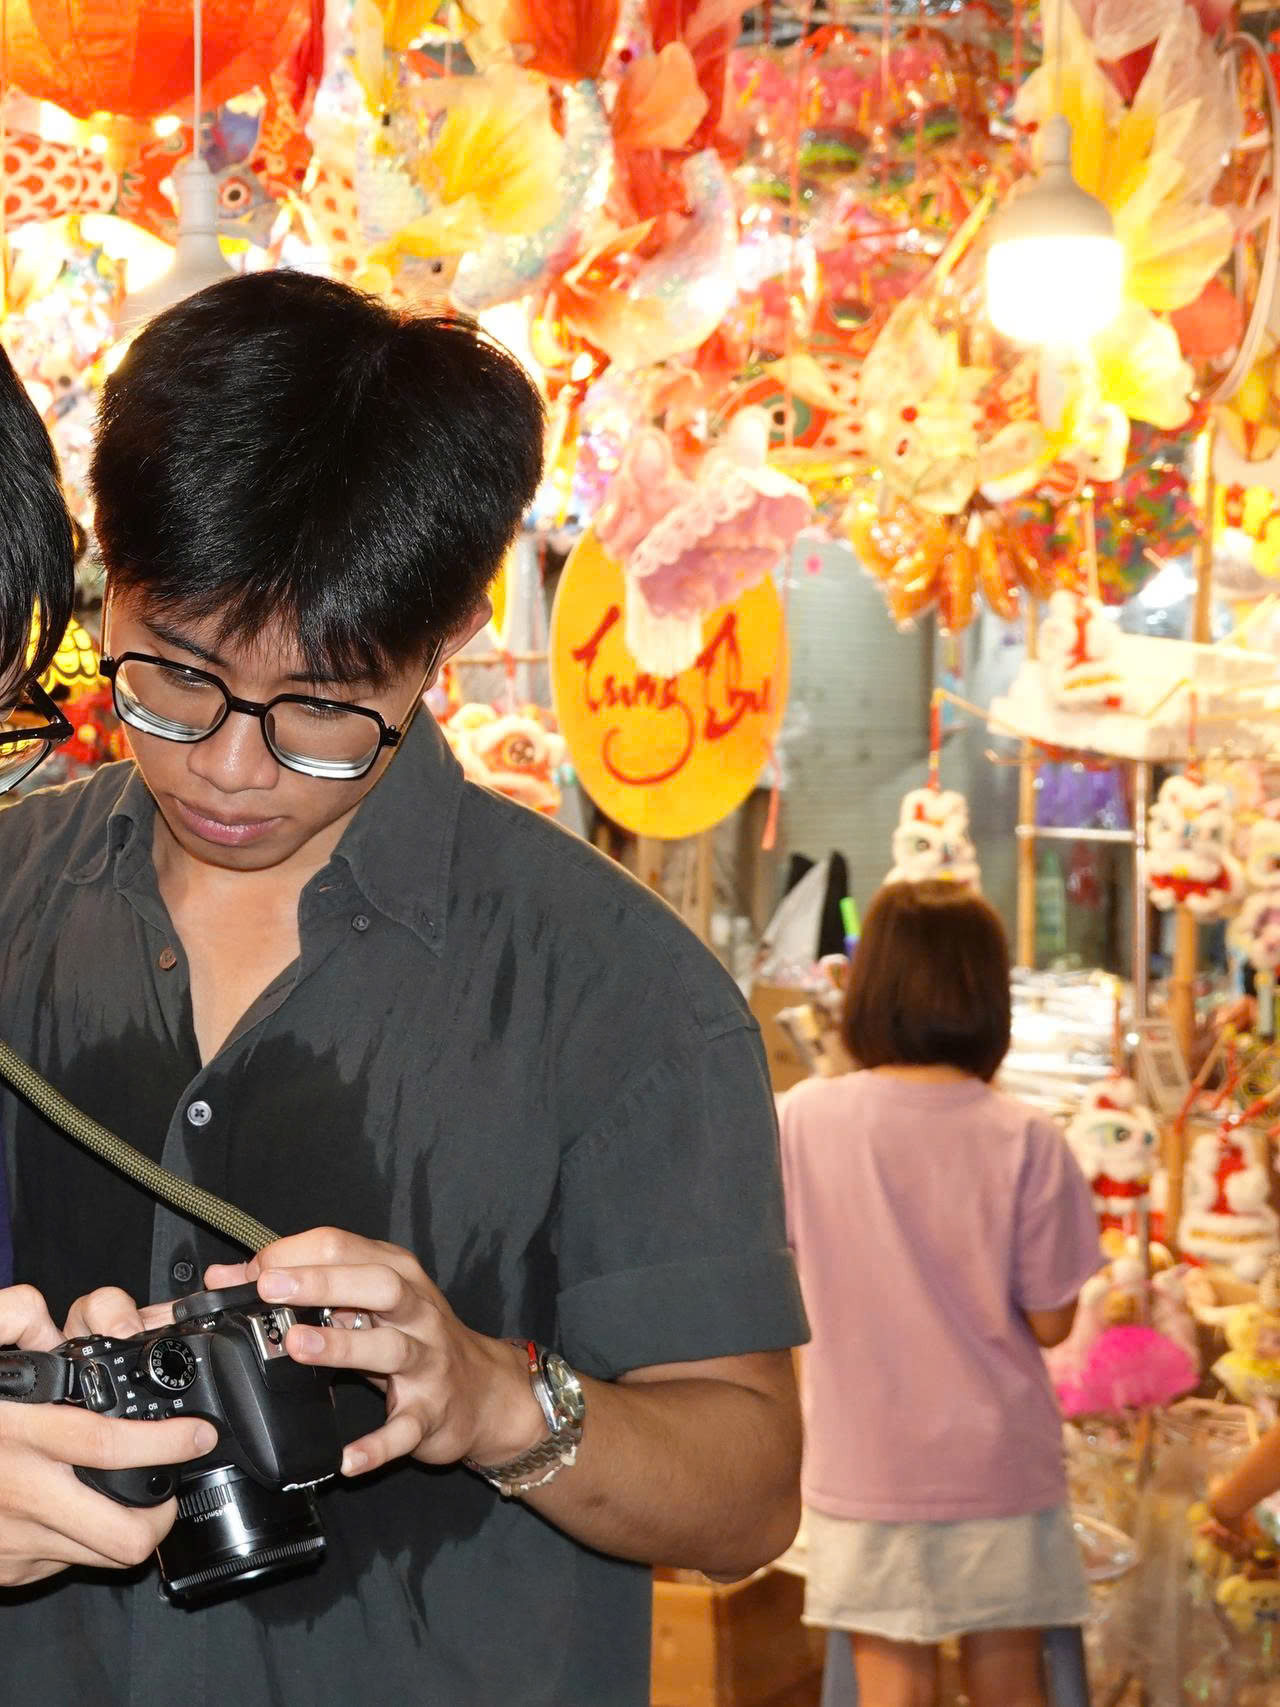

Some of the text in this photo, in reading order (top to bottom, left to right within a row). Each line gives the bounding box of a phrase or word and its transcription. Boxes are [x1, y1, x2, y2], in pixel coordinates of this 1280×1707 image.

[114, 1356, 124, 1365] OFF
[117, 1374, 127, 1382] ON
[148, 1402, 158, 1411] ISO
